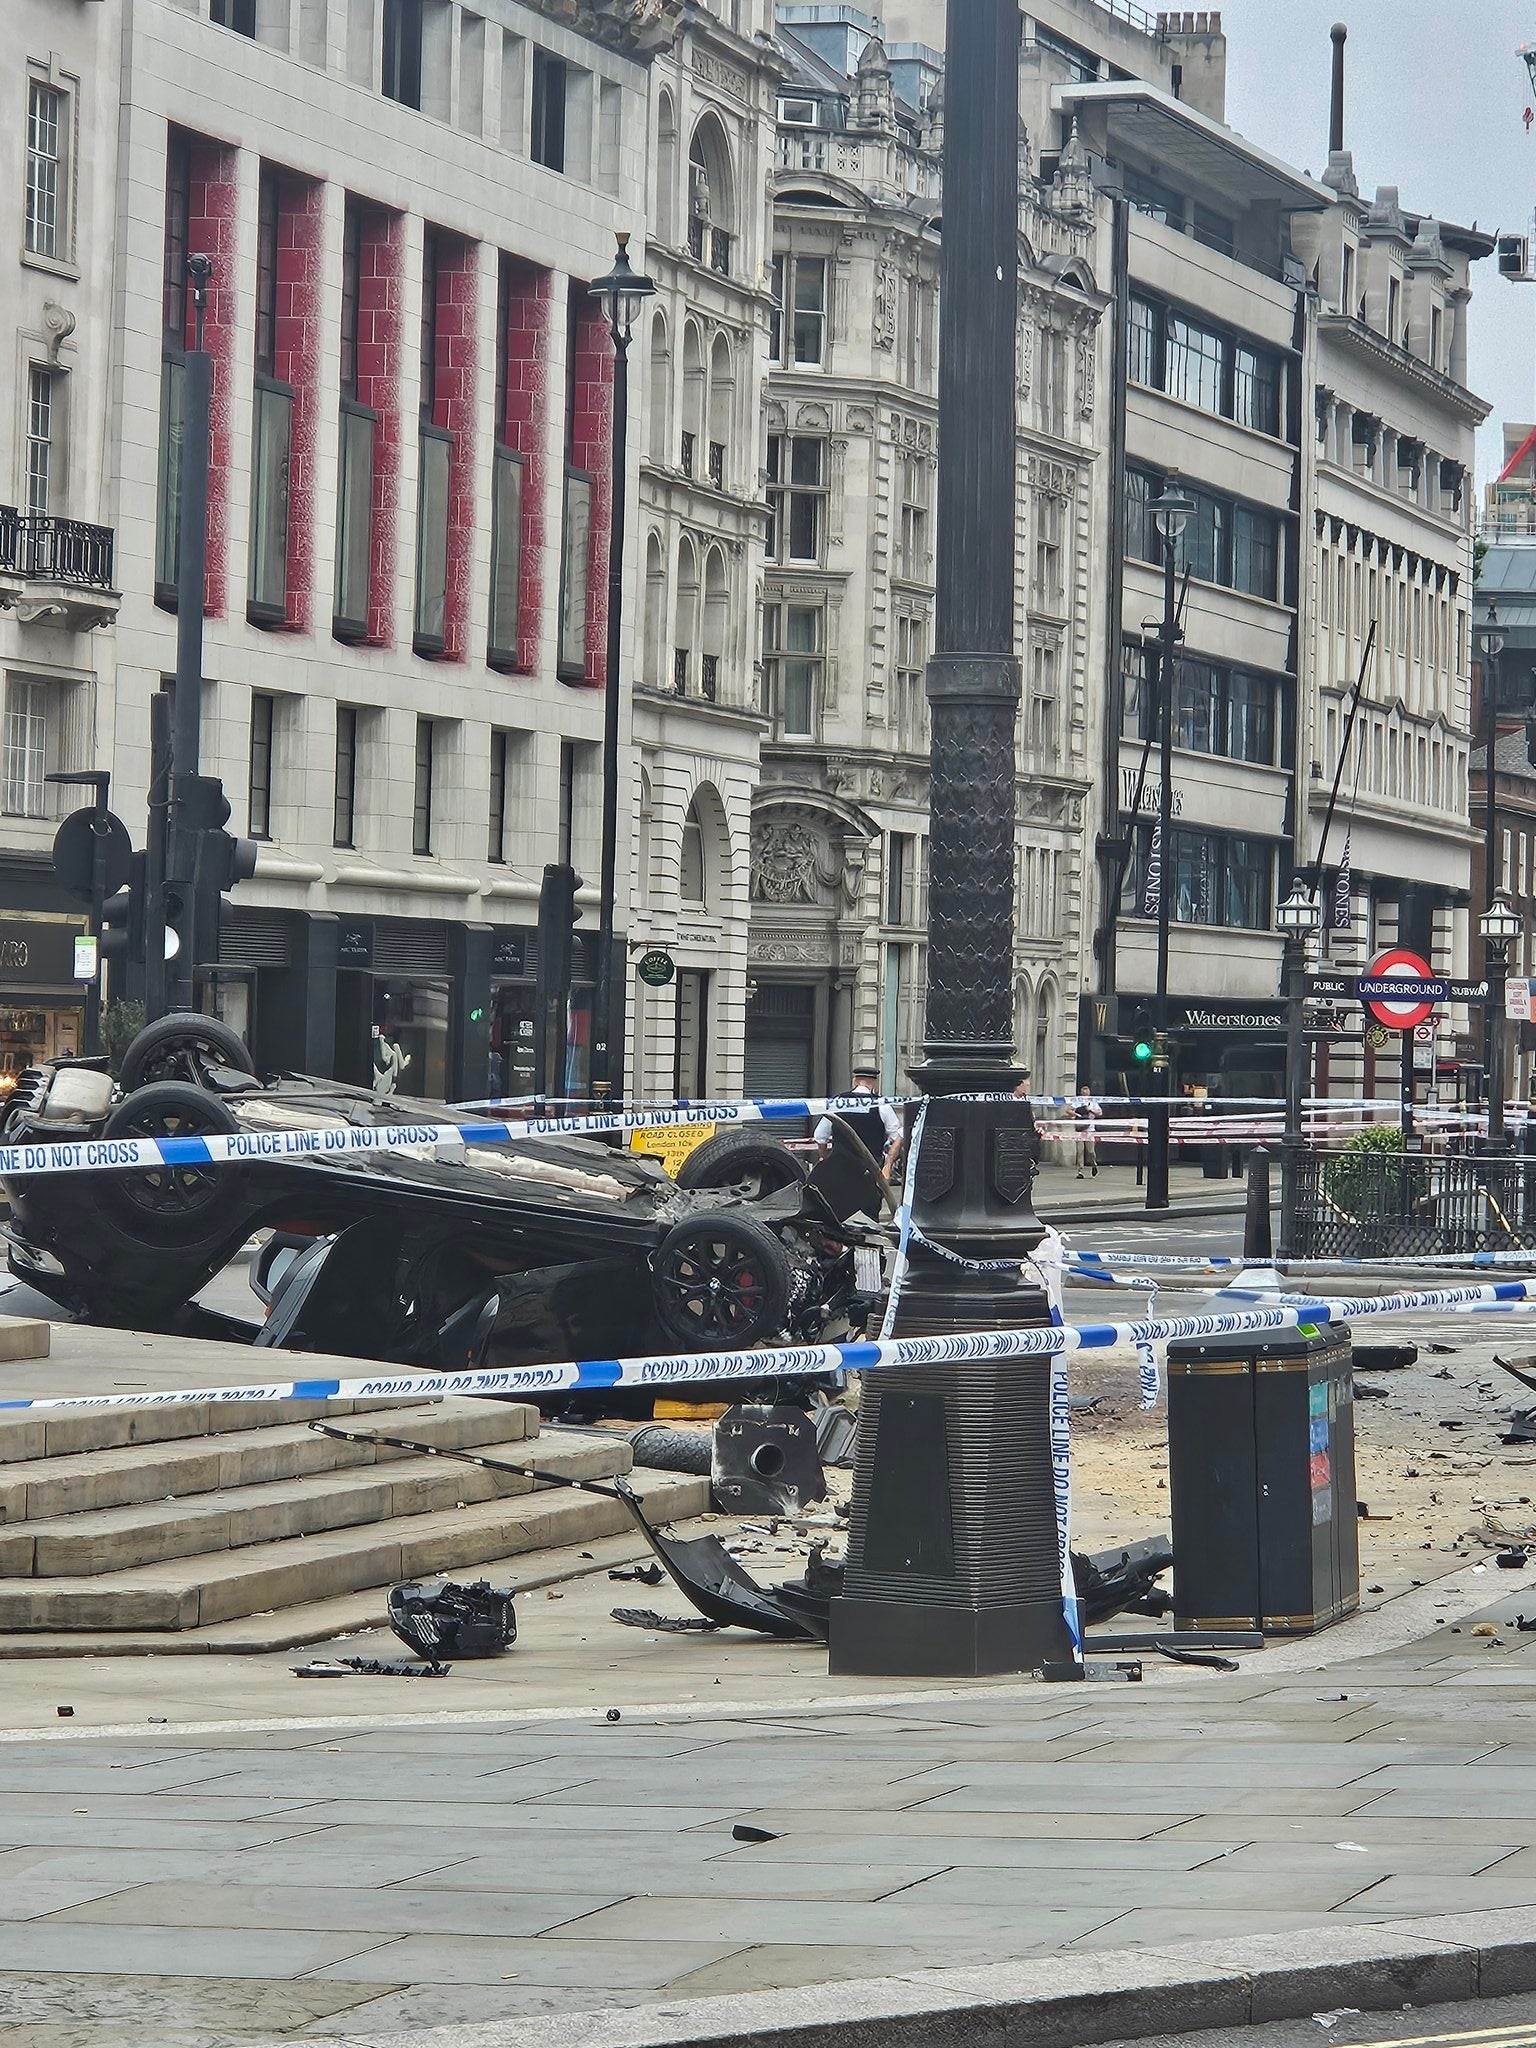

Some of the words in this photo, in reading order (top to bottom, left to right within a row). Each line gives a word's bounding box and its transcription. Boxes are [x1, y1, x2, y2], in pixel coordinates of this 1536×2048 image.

[1313, 981, 1345, 992] PUBLIC
[1359, 982, 1443, 995] UNDERGROUND
[1185, 1010, 1282, 1026] Waterstones
[595, 1042, 608, 1051] 02
[526, 1116, 582, 1134] POLICE
[585, 1114, 620, 1132] LINE
[625, 1111, 646, 1127] DO
[650, 1109, 681, 1125] NOT
[685, 1106, 739, 1122] CROSS
[226, 1134, 281, 1157] POLICE
[286, 1131, 321, 1152] LINE
[325, 1129, 346, 1149] DO
[351, 1127, 380, 1147] NOT
[386, 1125, 439, 1145] CROSS
[640, 1131, 665, 1140] ROAD
[667, 1130, 704, 1139] CLOSED
[25, 1147, 47, 1169] DO
[51, 1145, 82, 1167] NOT
[87, 1142, 140, 1166] CROSS
[1020, 1328, 1065, 1352] POLICE
[1128, 1319, 1170, 1342] CROSS
[893, 1340, 941, 1364] CROSS
[939, 1337, 968, 1360] NOT
[967, 1335, 989, 1357] DO
[720, 1355, 743, 1375] DO
[779, 1349, 826, 1370] POLICE
[1052, 1371, 1070, 1425] POLICE
[1052, 1429, 1070, 1463] LINE
[1054, 1468, 1070, 1490] DO
[1055, 1494, 1069, 1526] NOT
